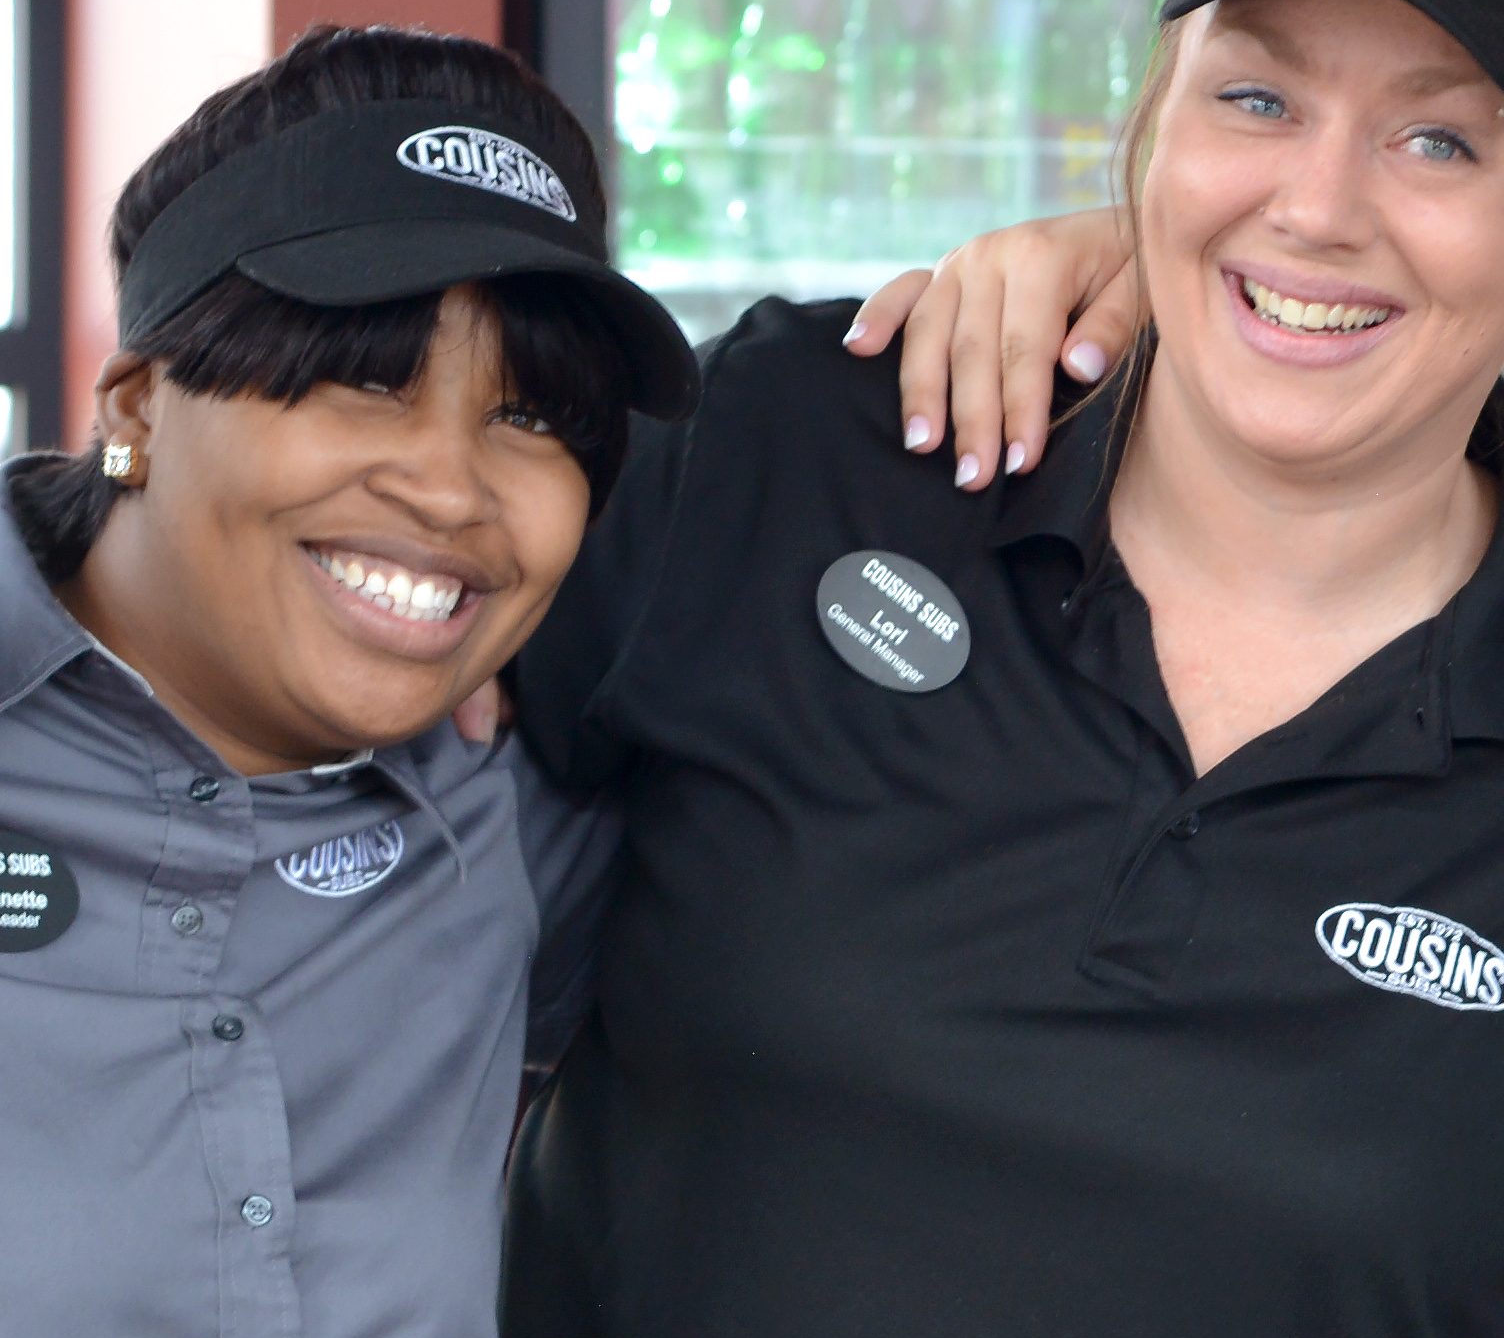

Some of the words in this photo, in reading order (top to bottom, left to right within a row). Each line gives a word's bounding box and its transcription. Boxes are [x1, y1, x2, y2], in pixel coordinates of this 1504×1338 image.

[416, 136, 570, 219] COUSINS
[861, 557, 924, 614] COUSINS
[917, 601, 960, 643] SUBS
[827, 603, 877, 647] General
[871, 637, 925, 685] Manager
[7, 852, 52, 877] SUBS
